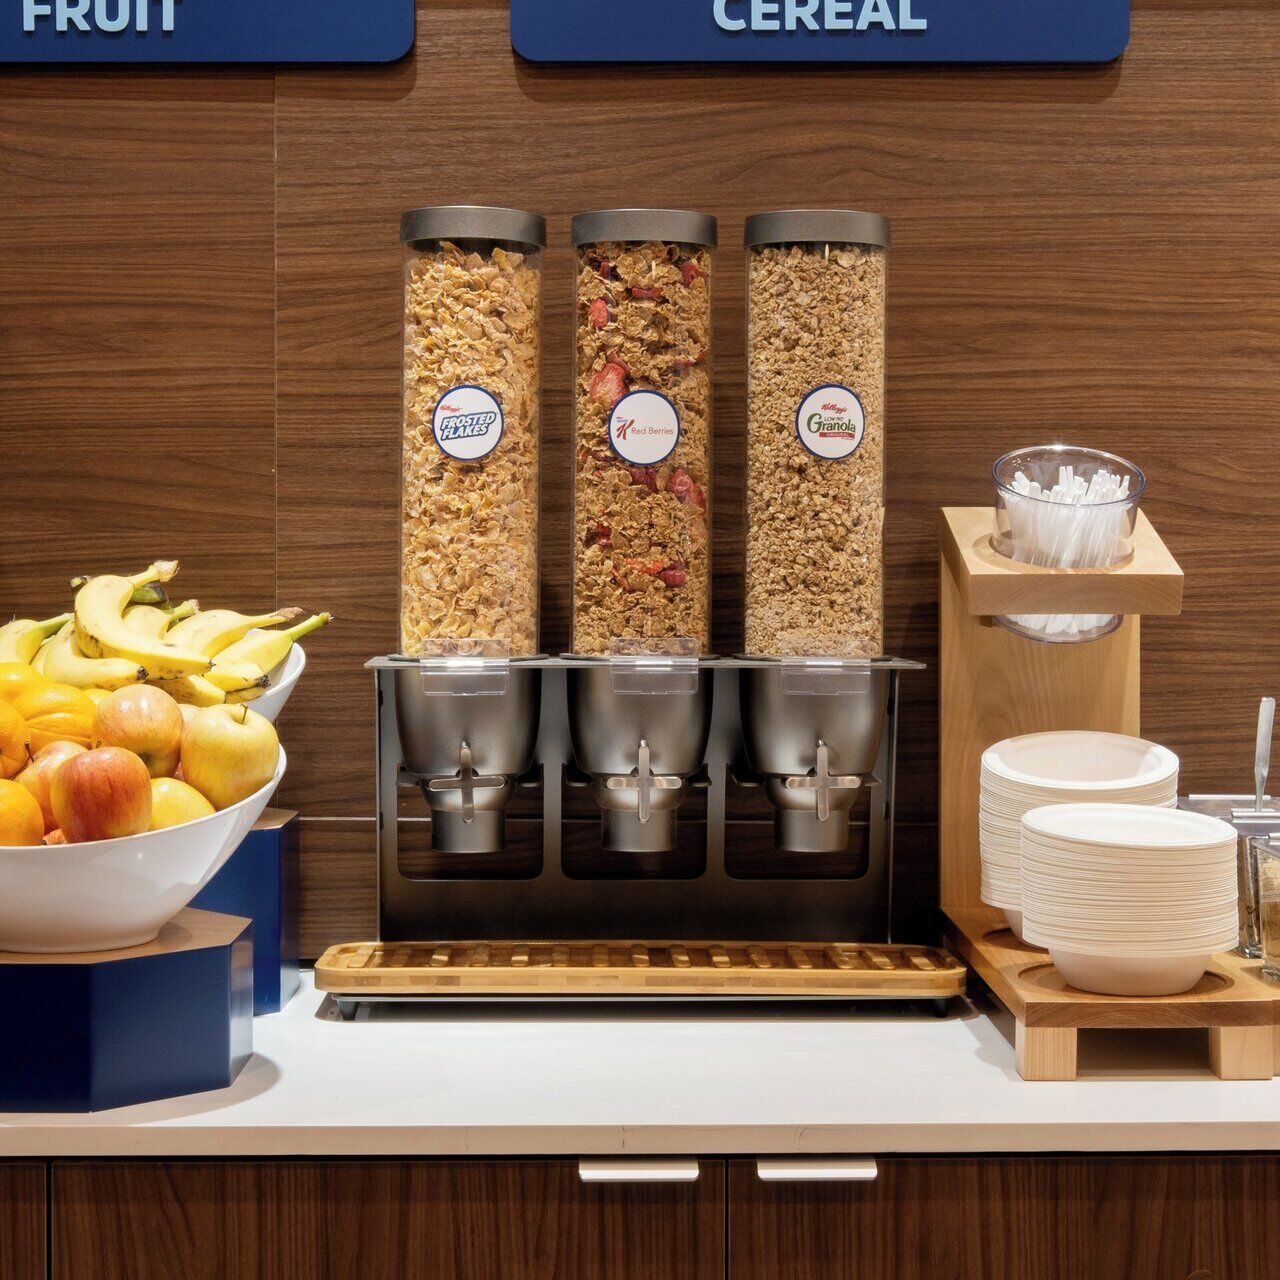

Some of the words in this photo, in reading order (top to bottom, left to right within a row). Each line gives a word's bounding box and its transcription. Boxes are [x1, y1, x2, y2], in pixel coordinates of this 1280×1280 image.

[441, 412, 495, 430] FROSTED
[807, 413, 856, 433] Granola
[441, 424, 488, 440] FLAKES
[631, 427, 647, 435] Red
[648, 426, 674, 435] Berries
